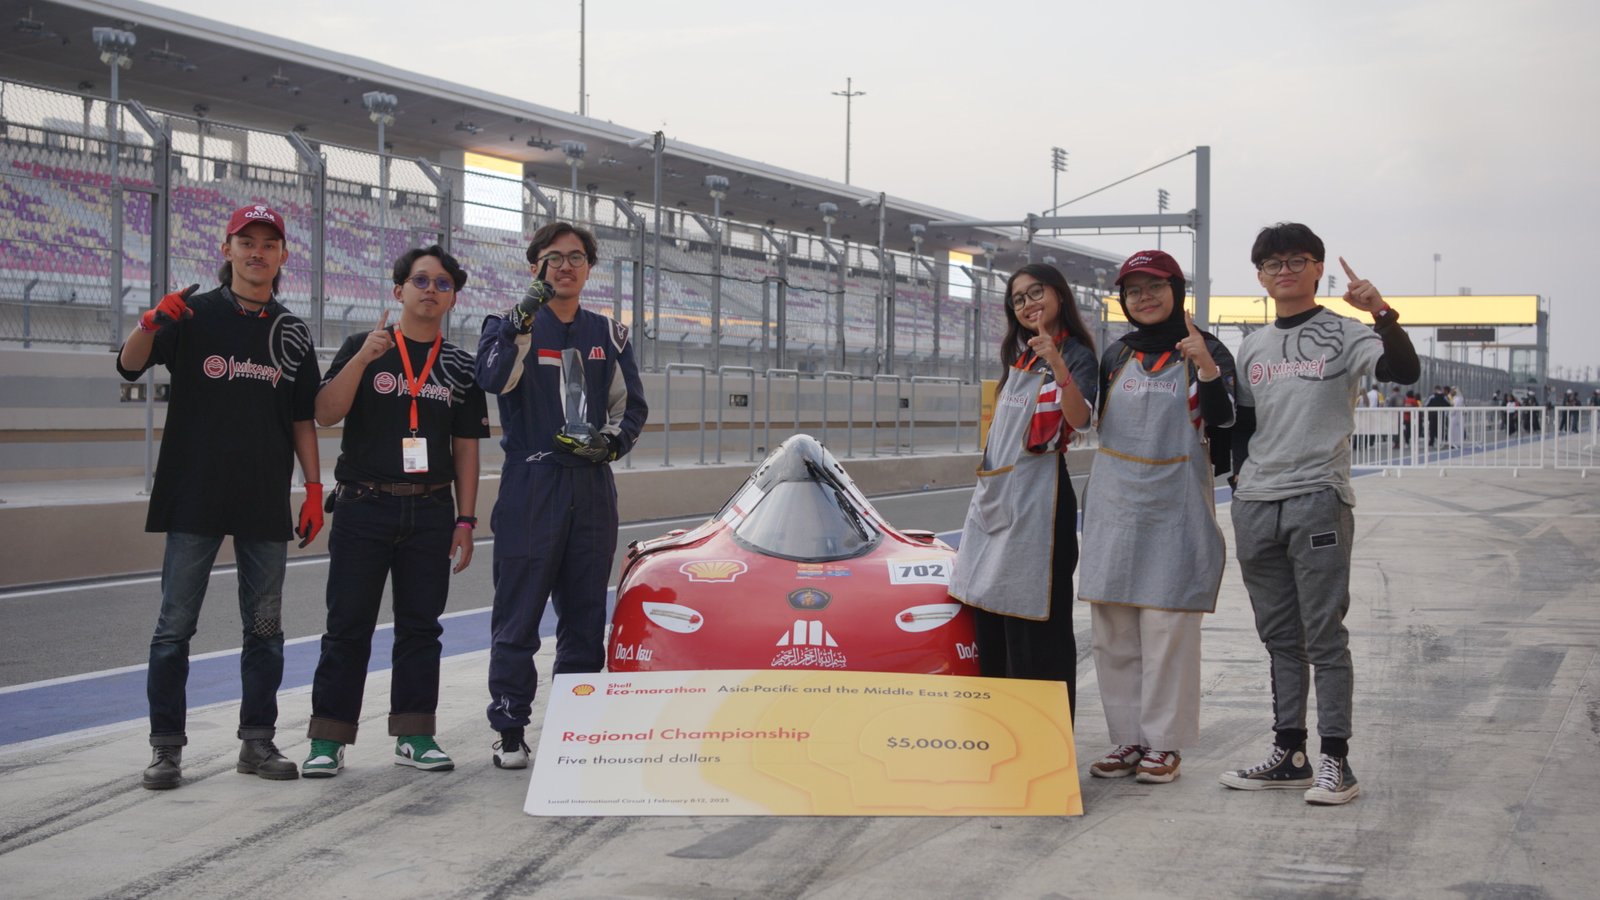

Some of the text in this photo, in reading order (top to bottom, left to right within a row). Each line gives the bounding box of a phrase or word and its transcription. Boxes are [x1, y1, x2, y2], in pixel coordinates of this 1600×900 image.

[244, 210, 275, 221] QATAR
[899, 564, 945, 578] 702
[606, 686, 706, 696] Eco-marathon
[717, 684, 991, 700] Asia-Pacific and the Middle East 2025
[561, 727, 810, 745] Regional Championship
[887, 737, 990, 751] $5,000.00
[557, 753, 721, 765] Five thousand dollars
